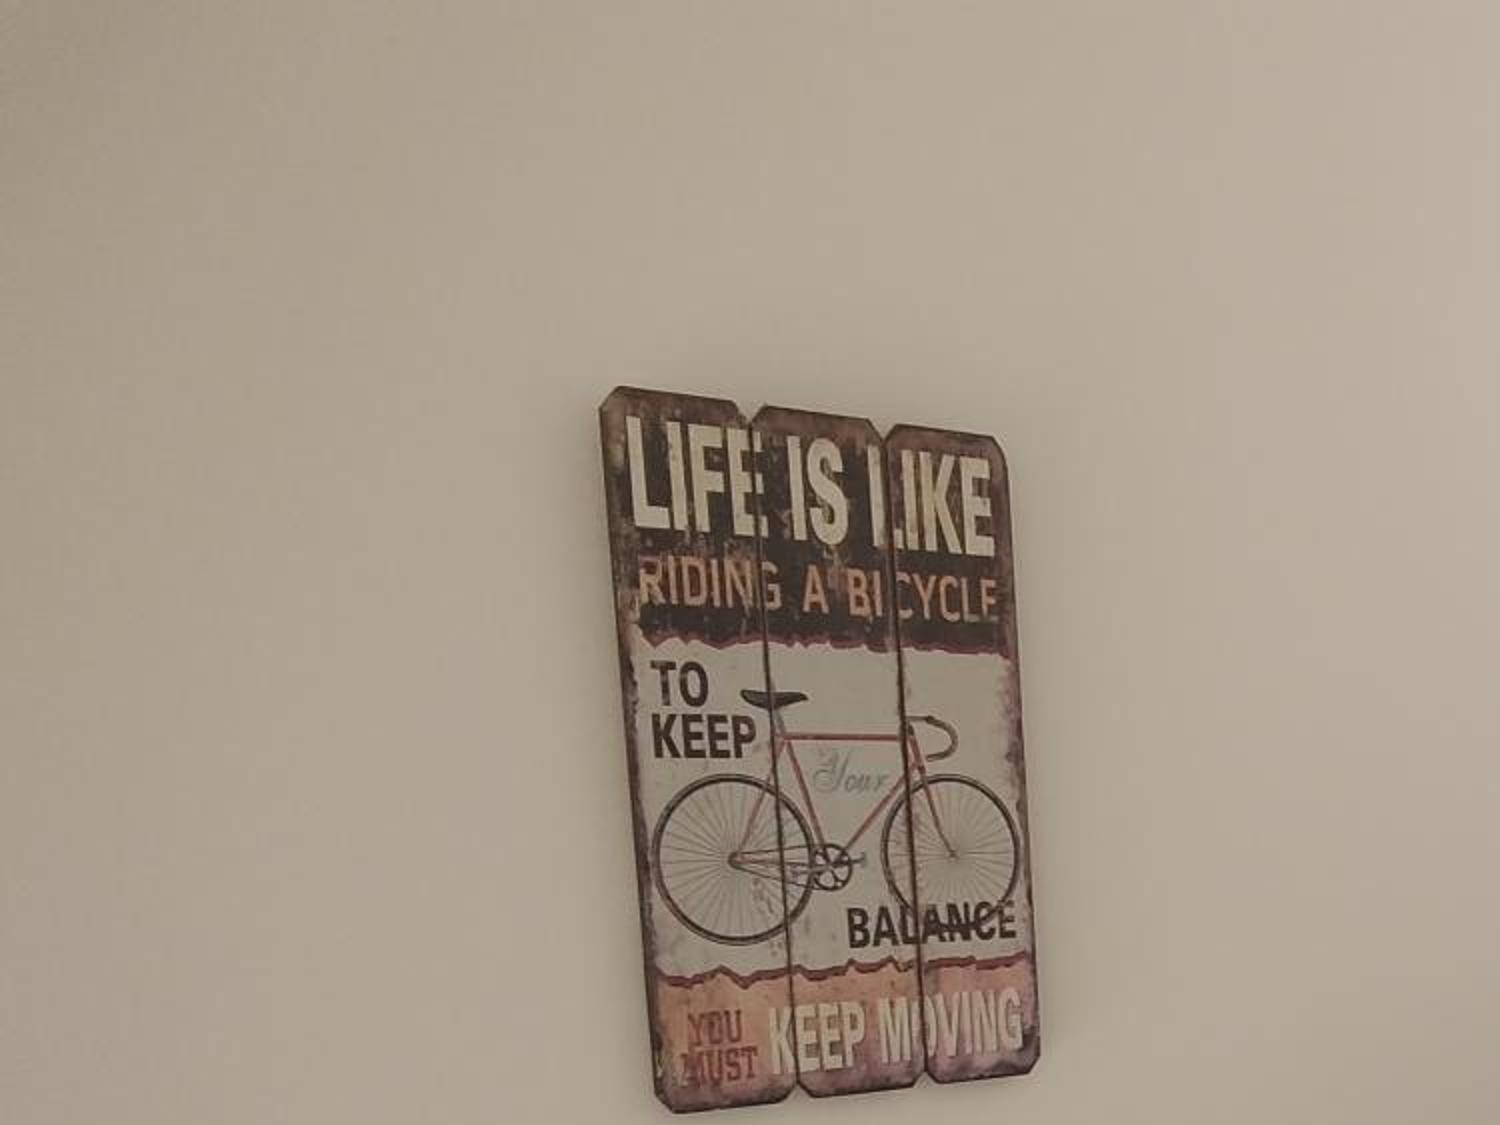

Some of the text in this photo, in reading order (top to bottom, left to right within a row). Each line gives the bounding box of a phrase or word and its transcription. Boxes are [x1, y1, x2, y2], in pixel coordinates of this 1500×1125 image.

[626, 415, 996, 558] LIFE IS LIKE
[639, 555, 999, 622] RIDING A BICYCLE
[650, 660, 708, 707] TO
[651, 713, 756, 759] KEEP
[813, 751, 890, 794] Your
[847, 901, 1017, 949] BALANCE
[687, 1010, 742, 1044] YOU
[768, 986, 1024, 1075] KEEP MOVING
[680, 1046, 758, 1086] MUST
